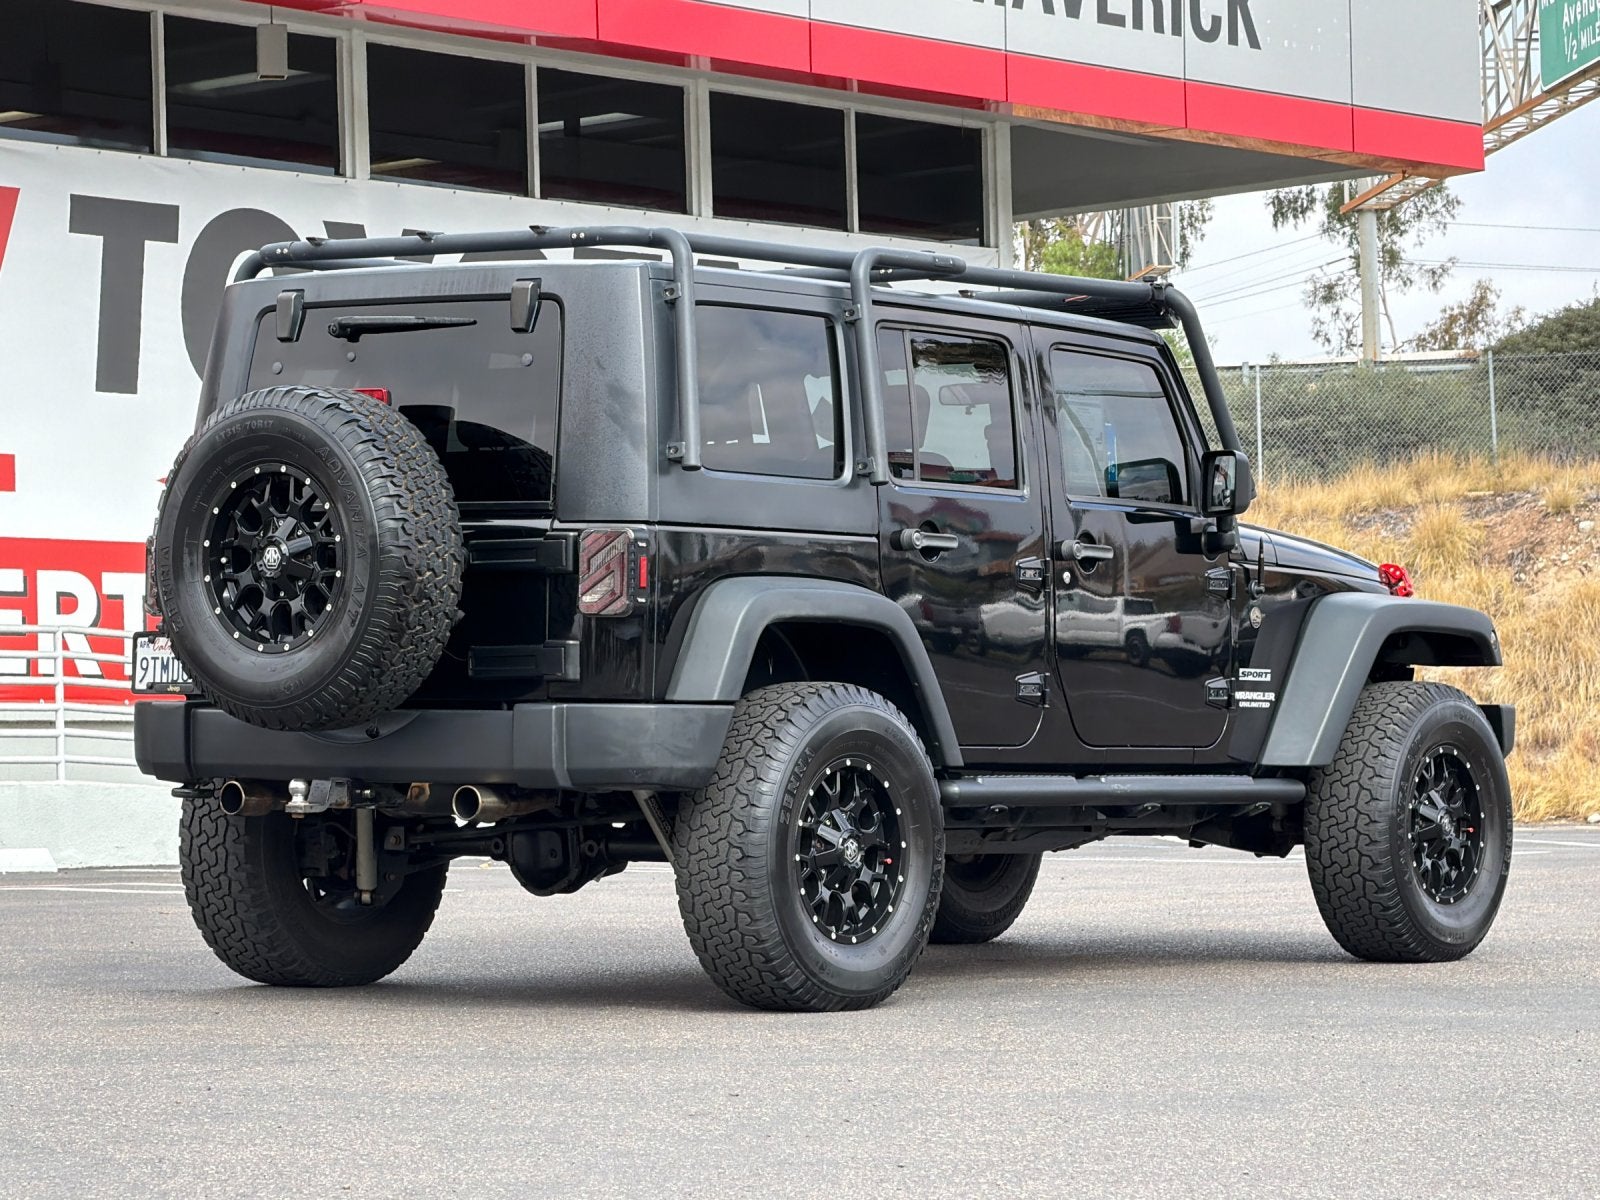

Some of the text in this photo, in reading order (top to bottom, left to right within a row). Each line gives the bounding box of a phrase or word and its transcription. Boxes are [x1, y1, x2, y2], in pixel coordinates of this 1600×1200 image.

[1239, 670, 1271, 679] SPORT
[167, 684, 181, 692] Jeep
[1235, 691, 1275, 701] WRANGLER
